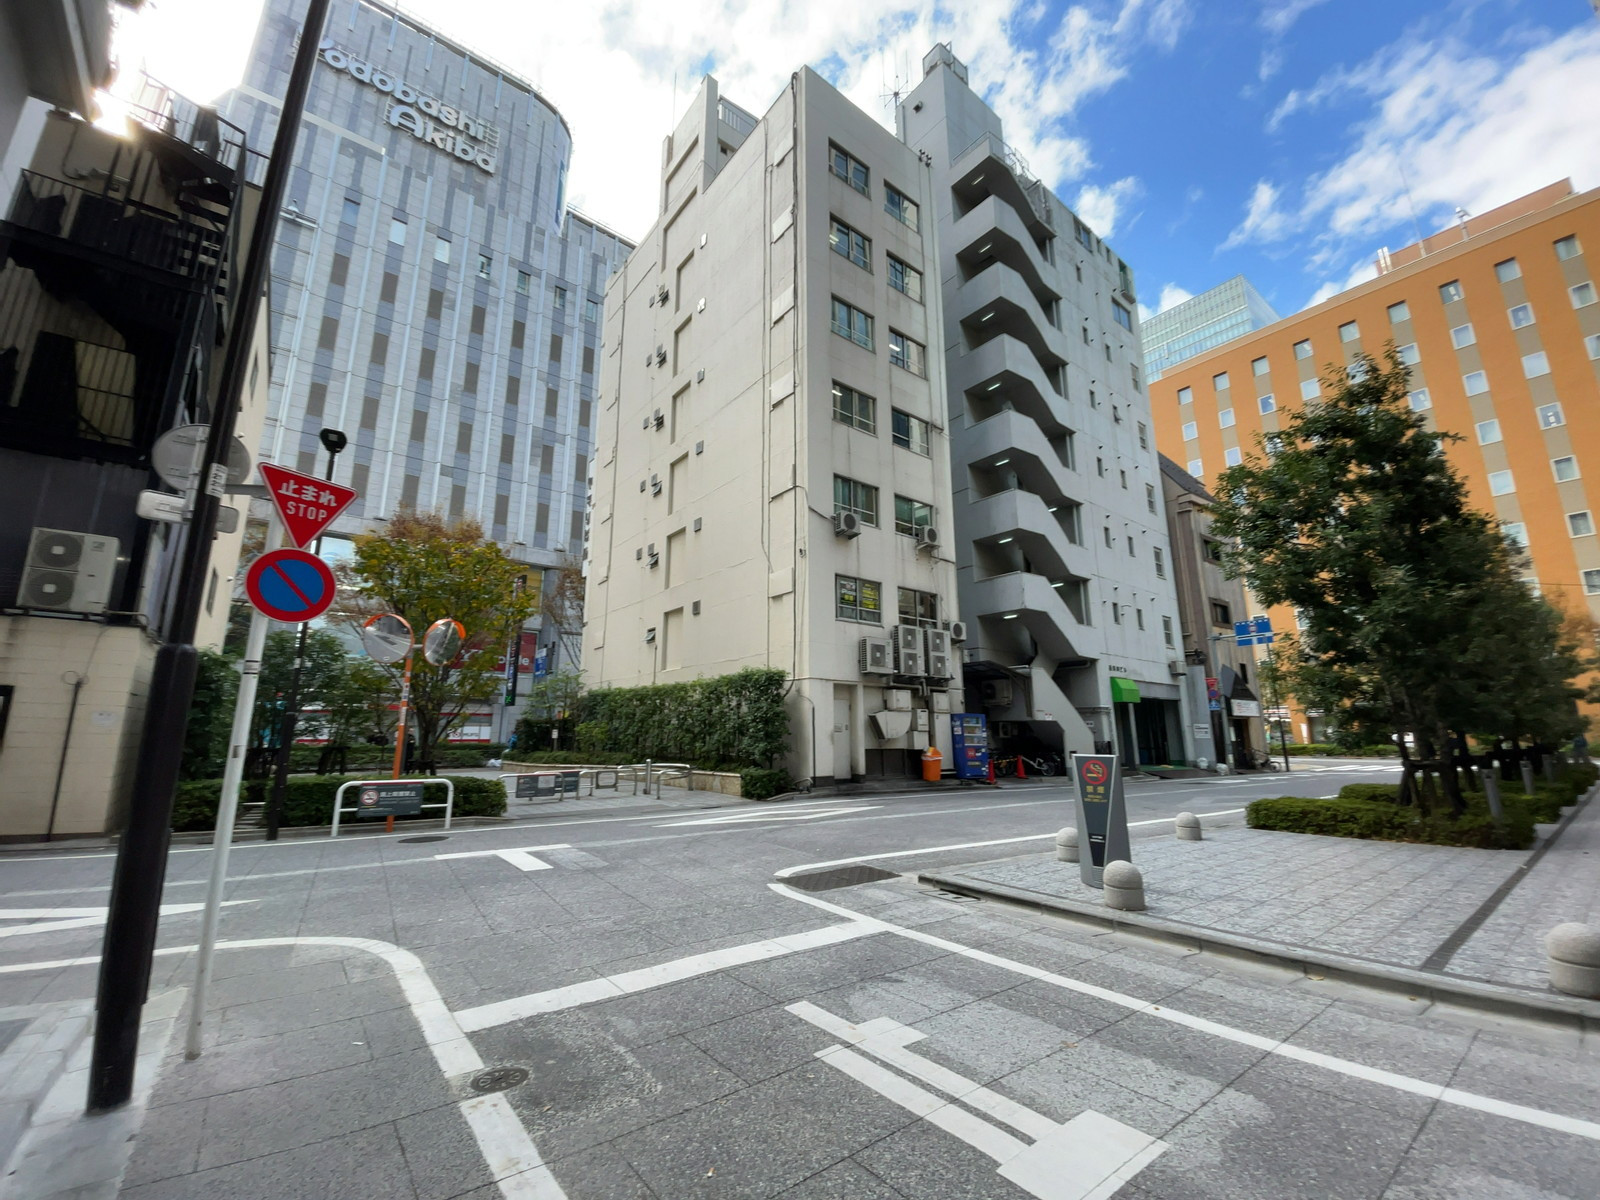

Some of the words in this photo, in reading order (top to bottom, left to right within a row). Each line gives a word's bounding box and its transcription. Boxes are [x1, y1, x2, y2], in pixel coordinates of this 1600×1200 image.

[389, 104, 496, 174] Akiba
[277, 479, 338, 507] 止まれ
[285, 501, 328, 522] STOP
